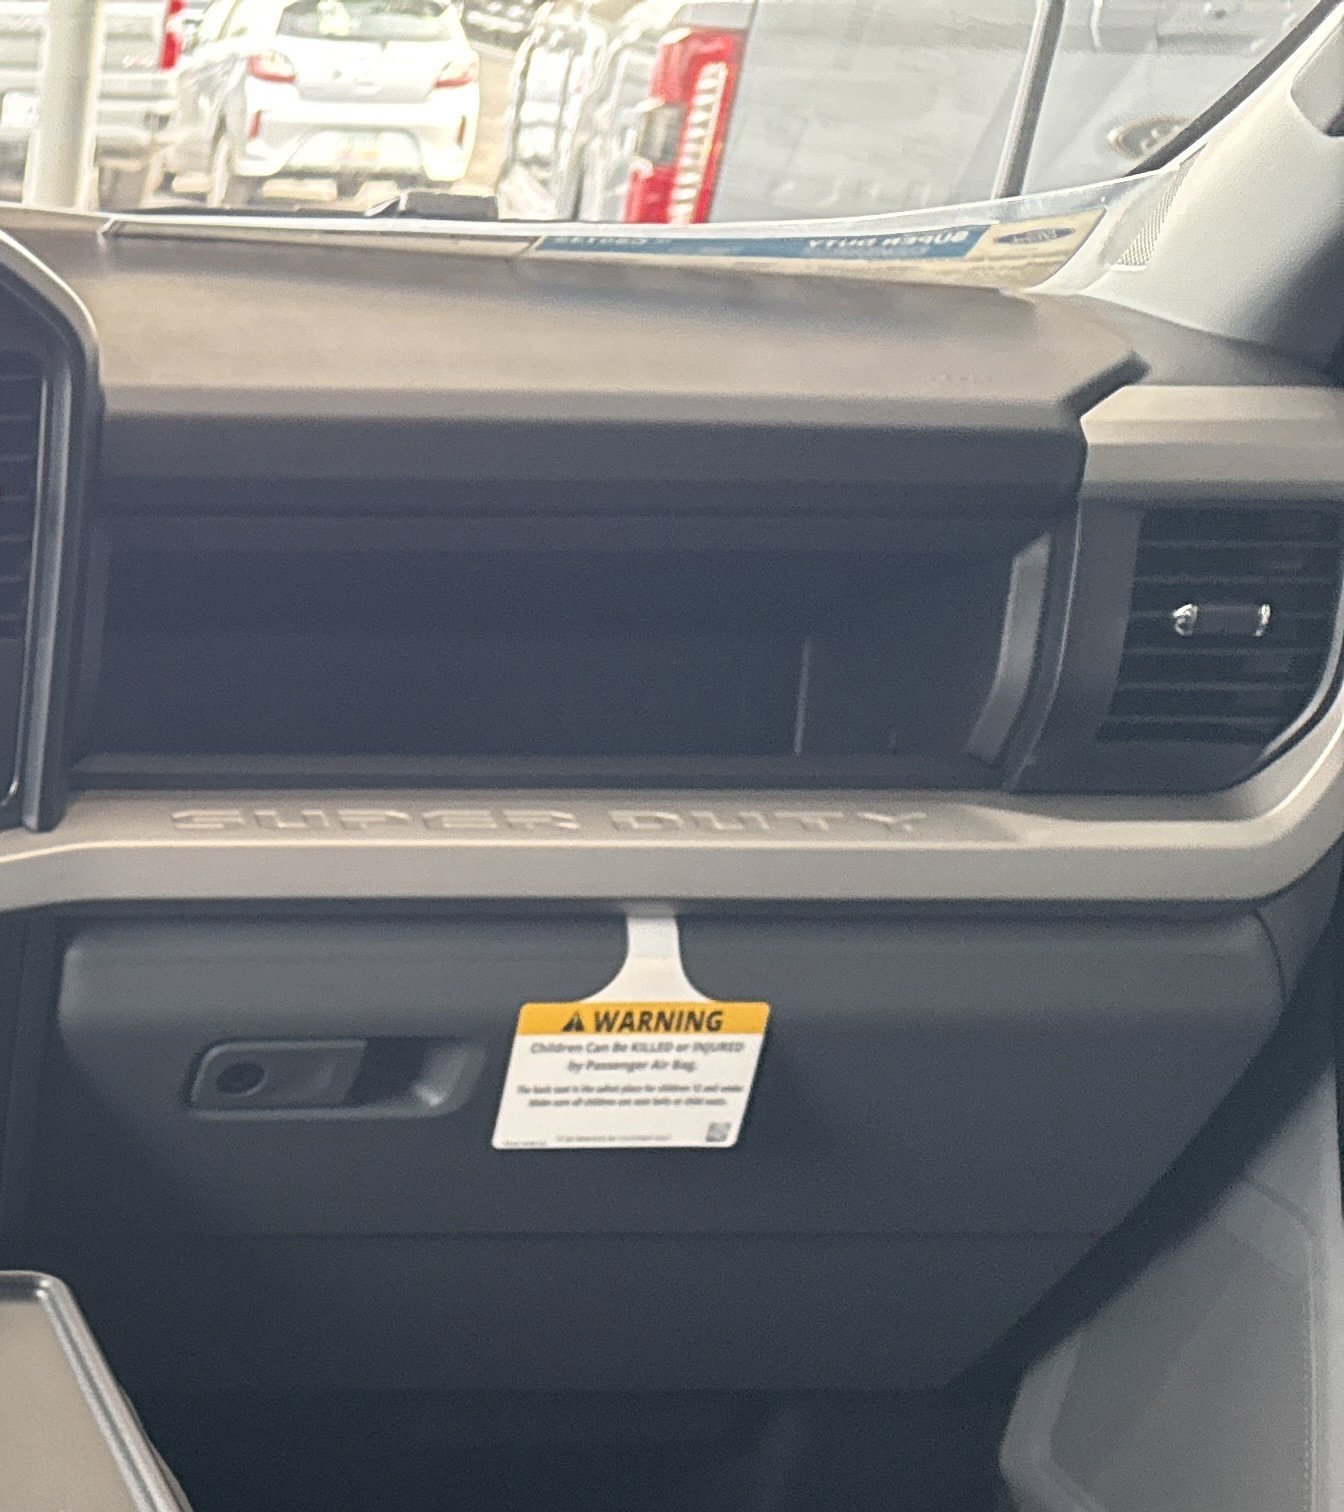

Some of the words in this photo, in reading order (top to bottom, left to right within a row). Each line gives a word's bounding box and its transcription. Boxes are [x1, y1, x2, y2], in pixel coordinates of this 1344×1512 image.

[170, 807, 580, 832] SUPER
[608, 808, 927, 833] DUTY
[593, 1010, 723, 1032] WARNING
[530, 1042, 583, 1053] Children
[585, 1042, 609, 1053] Can
[631, 1042, 673, 1053] KILLED
[676, 1043, 690, 1052] or
[692, 1042, 744, 1054] INJURED
[567, 1061, 583, 1073] by
[586, 1060, 648, 1073] Passenger
[650, 1060, 669, 1070] Air
